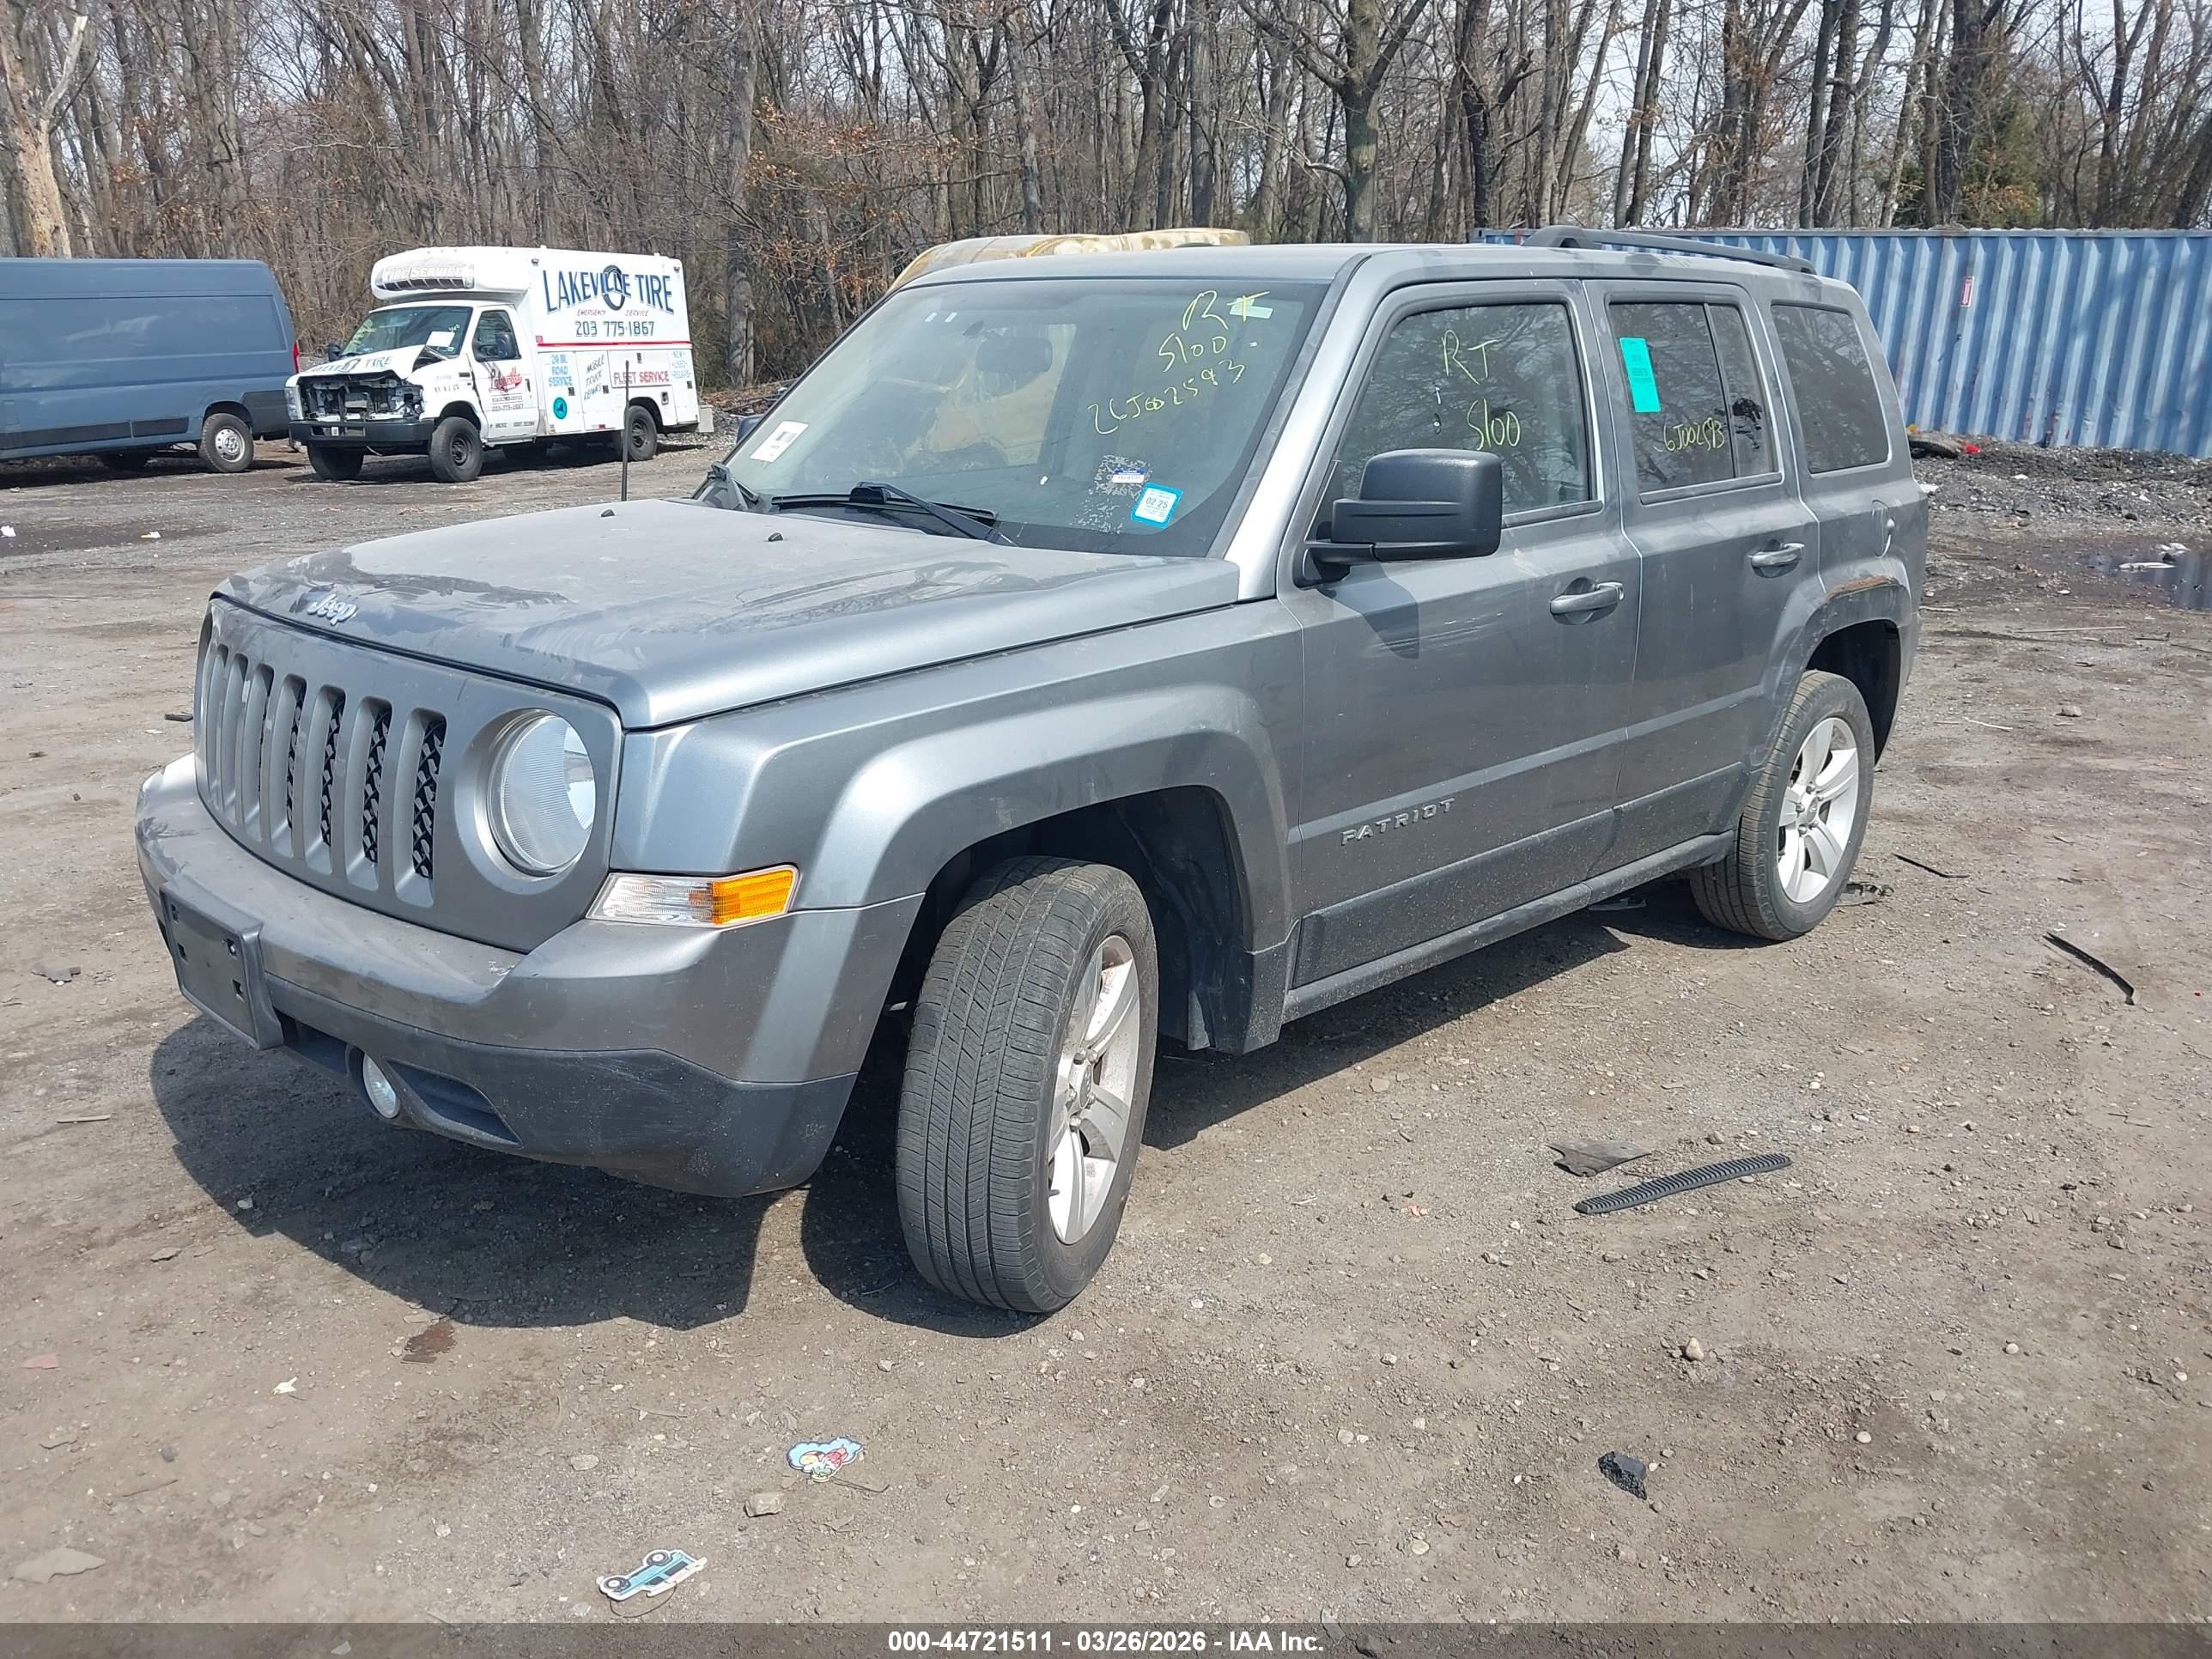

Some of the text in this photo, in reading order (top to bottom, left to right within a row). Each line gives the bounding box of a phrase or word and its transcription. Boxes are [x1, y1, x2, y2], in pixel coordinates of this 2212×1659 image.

[543, 270, 675, 314] LAKEVILLE TIRE
[576, 308, 606, 317] EMERGENCY
[574, 320, 598, 337] 203
[365, 356, 392, 370] TIRE
[548, 375, 574, 387] SERVICE
[613, 370, 670, 386] FLEET SERVICE
[307, 593, 359, 626] Jeep
[1340, 797, 1456, 846] PATRIOT
